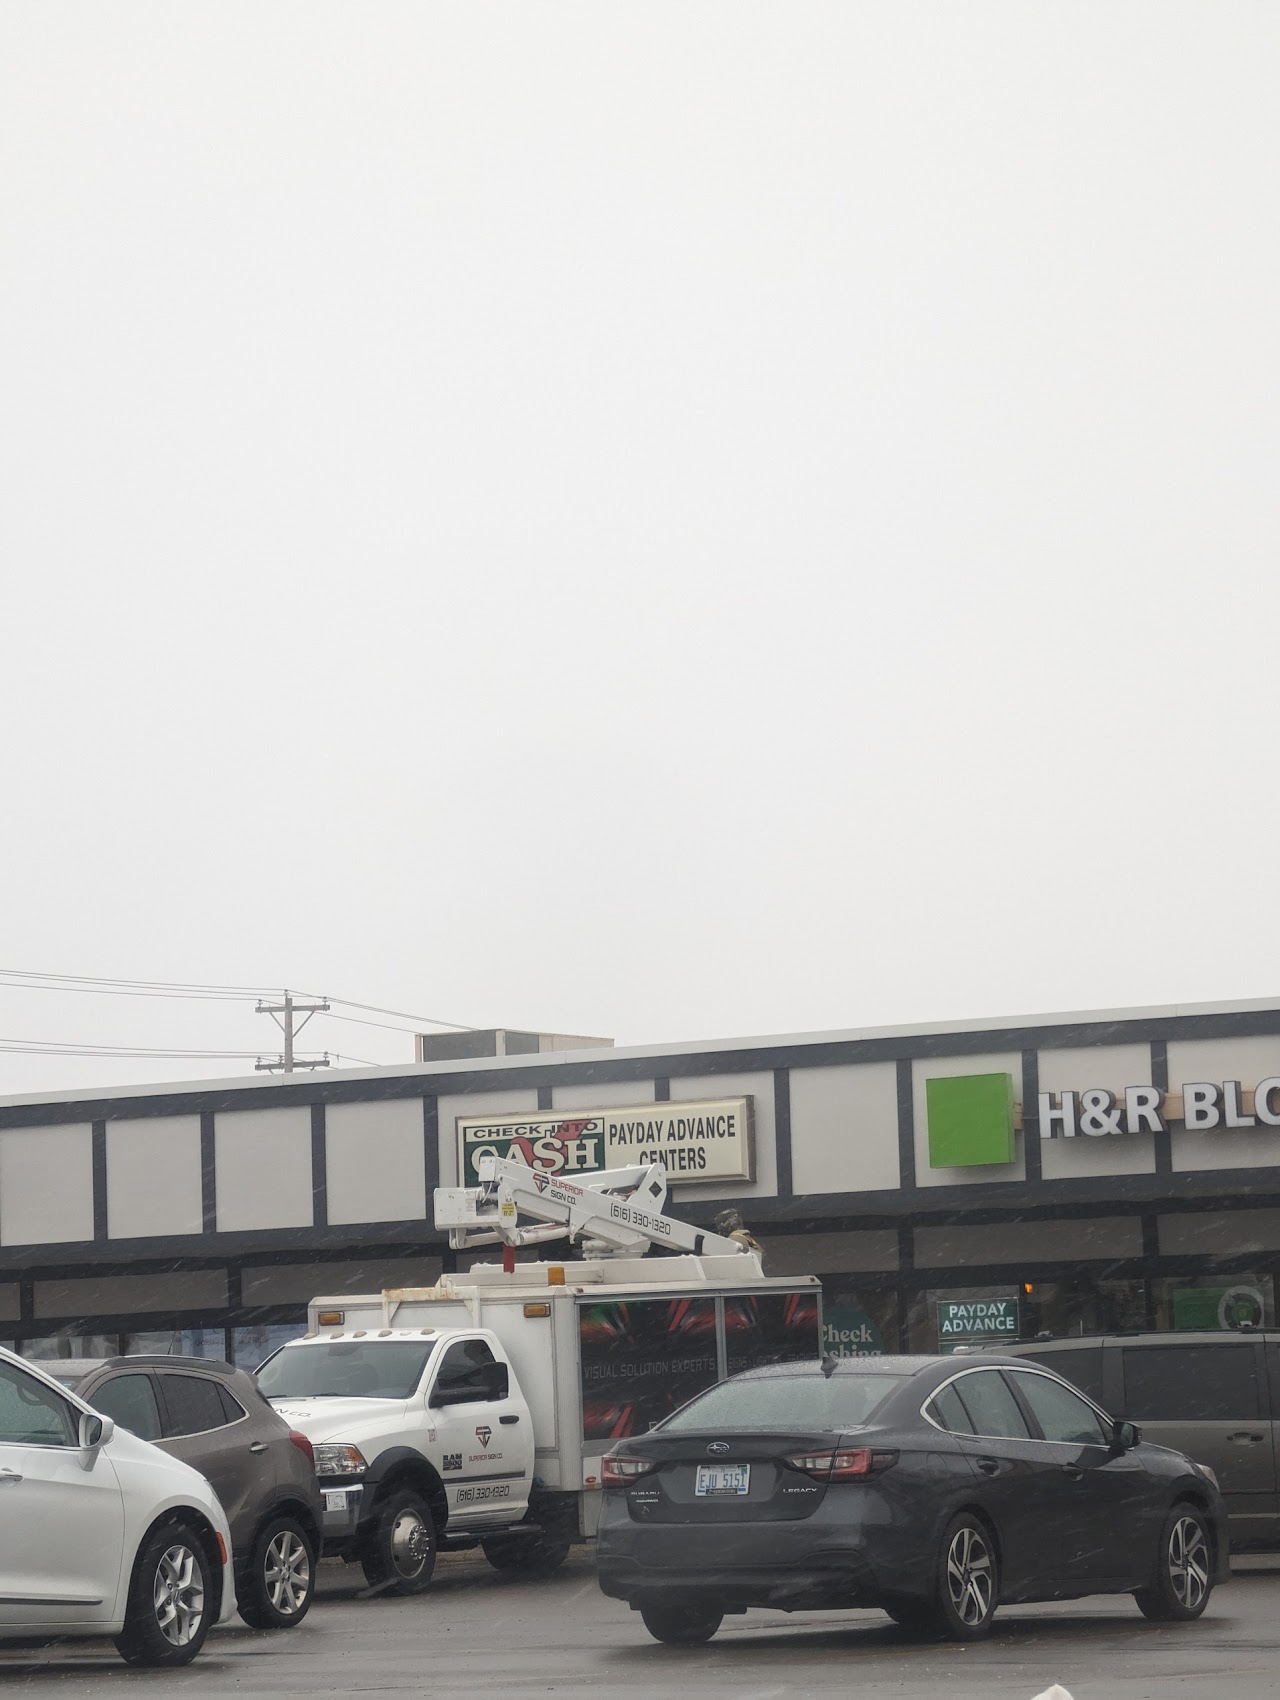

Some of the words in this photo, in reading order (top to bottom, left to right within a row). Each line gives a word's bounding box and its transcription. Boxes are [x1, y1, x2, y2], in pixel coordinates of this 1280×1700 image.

[1038, 1085, 1164, 1139] H&R
[473, 1125, 542, 1139] CHECK
[551, 1121, 598, 1134] INTO
[609, 1120, 664, 1146] PAYDAY
[666, 1115, 736, 1142] ADVANCE
[639, 1146, 706, 1172] CENTERS
[550, 1179, 584, 1197] SUPERIOR
[550, 1189, 567, 1202] SIGN
[566, 1196, 577, 1206] CO.
[610, 1202, 631, 1224] (616)
[632, 1211, 671, 1236] 330-1320
[949, 1302, 1007, 1318] PAYDAY
[942, 1317, 1015, 1333] ADVANCE
[584, 1366, 617, 1379] VISUAL
[620, 1361, 669, 1377] SOLUTION
[671, 1358, 715, 1373] EXPERTS
[700, 1474, 717, 1489] EJU
[722, 1472, 746, 1488] 5151
[457, 1487, 475, 1503] (616)
